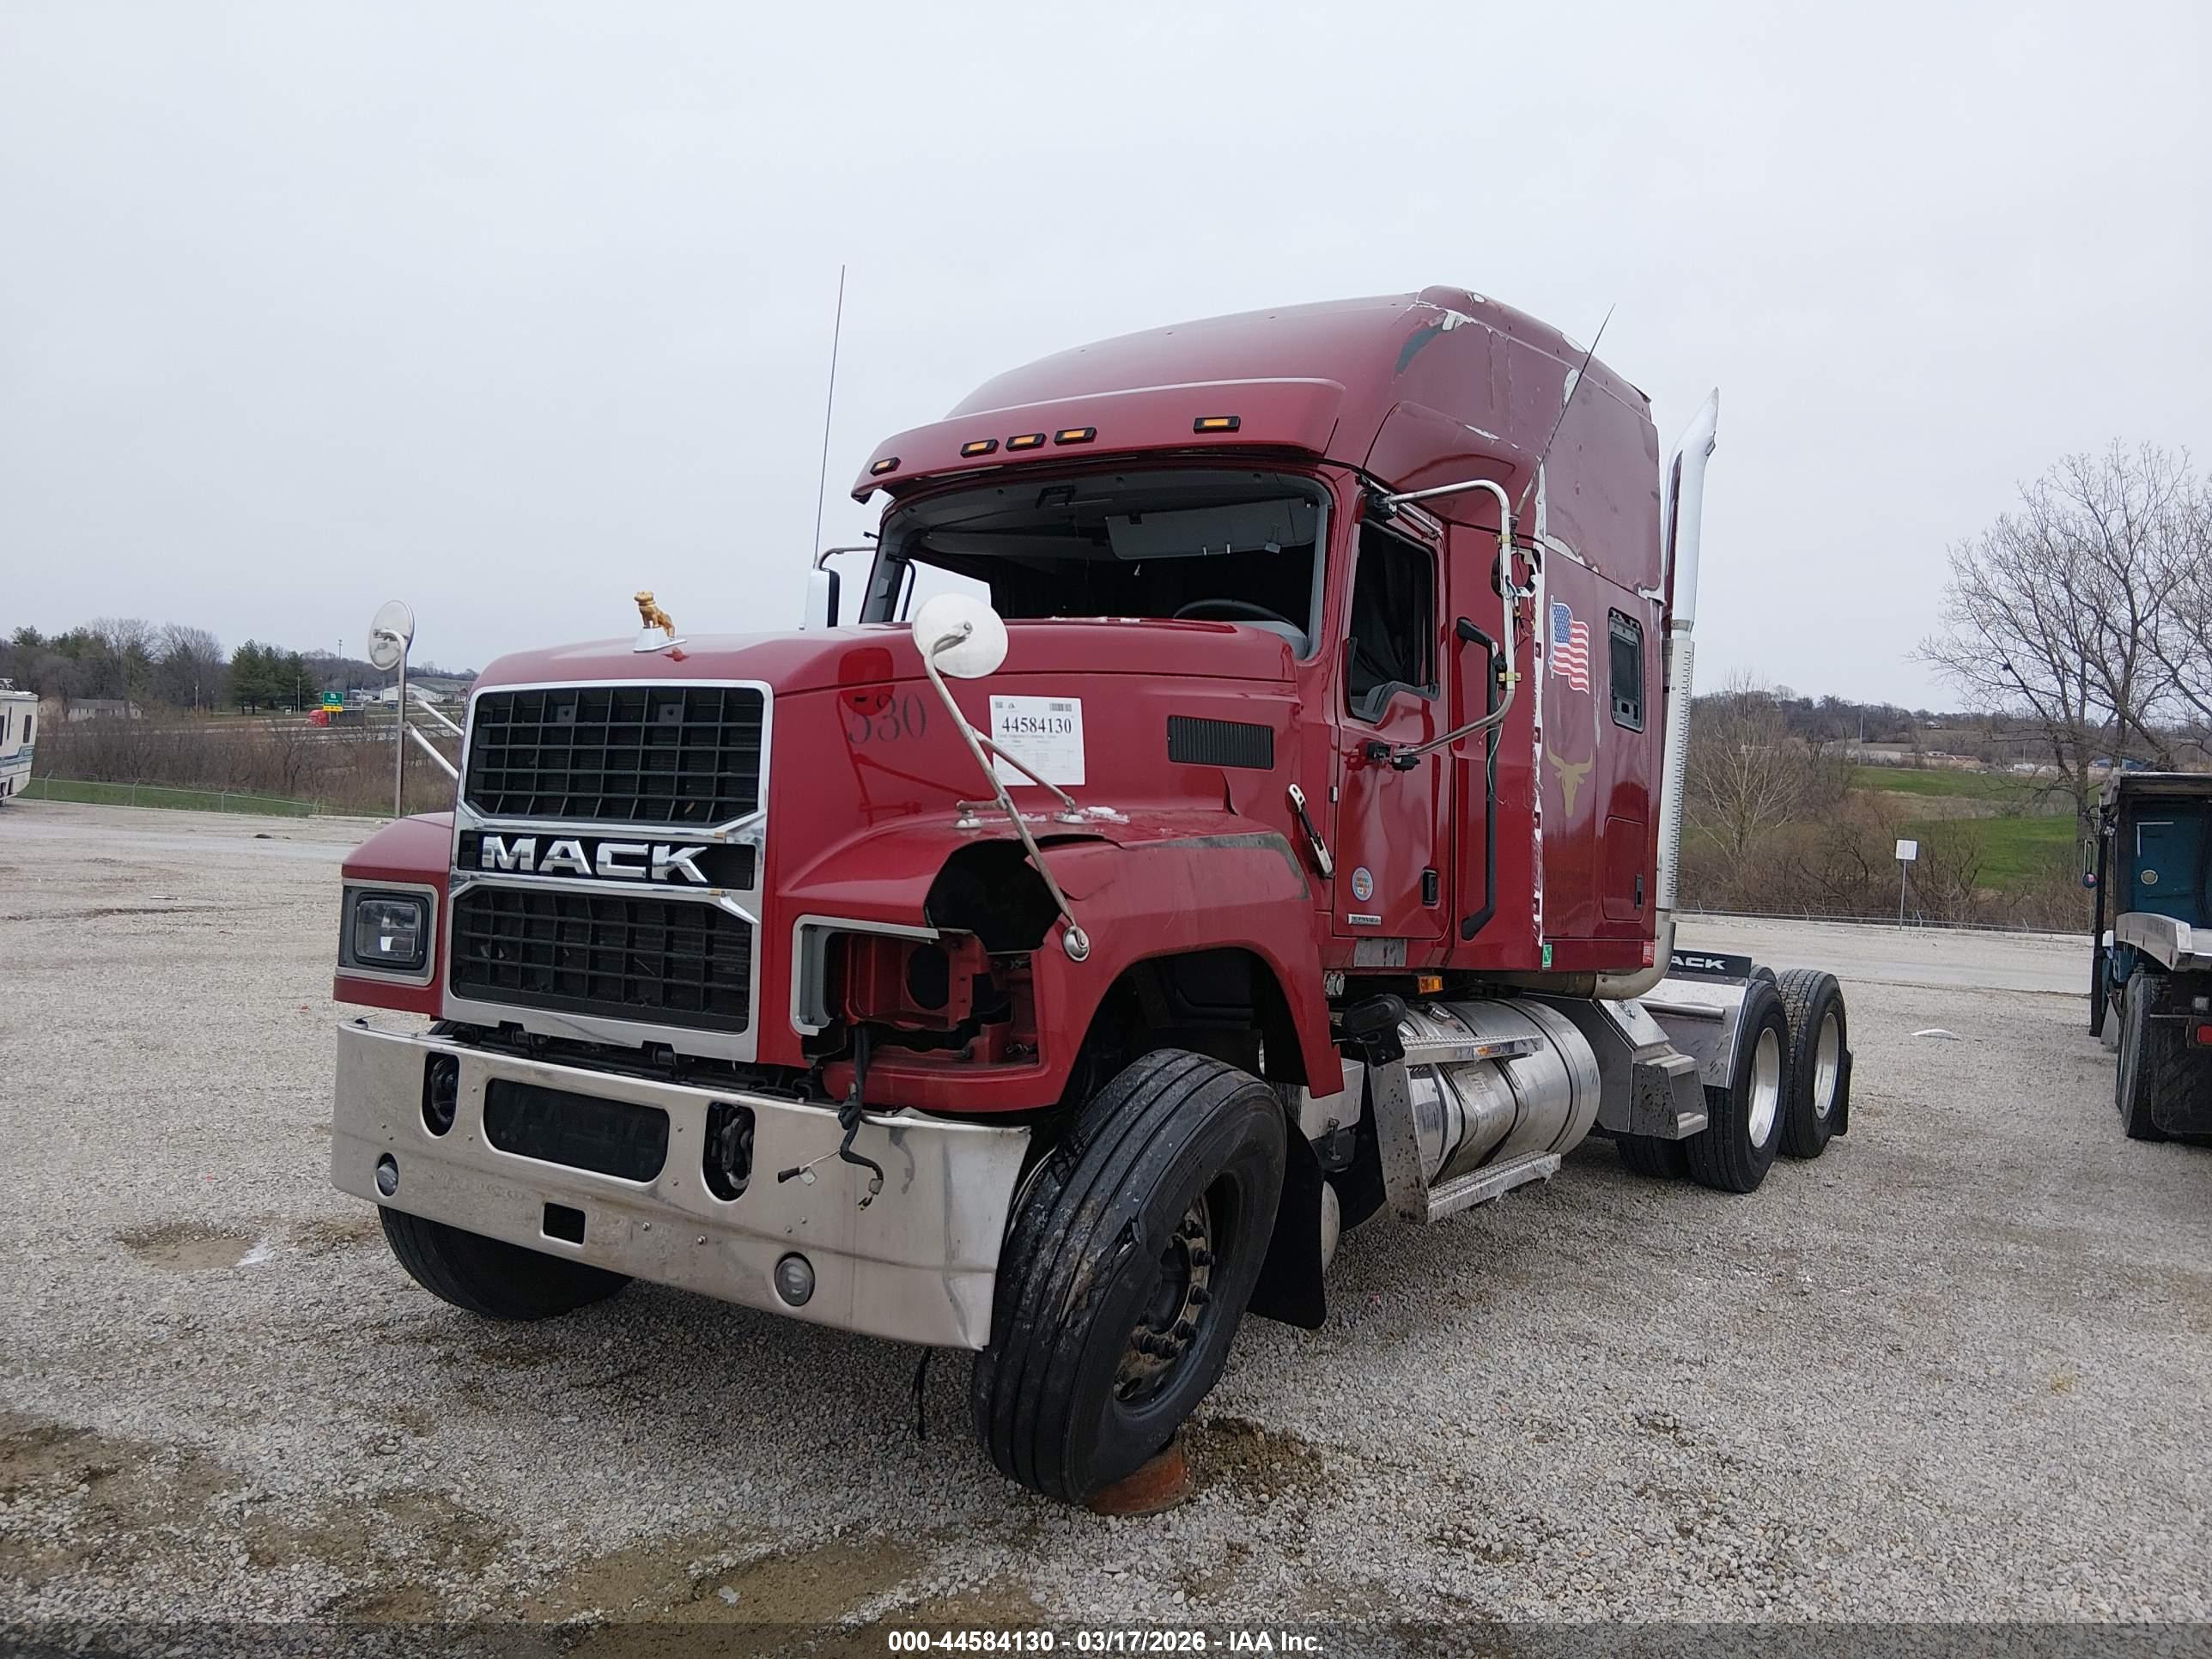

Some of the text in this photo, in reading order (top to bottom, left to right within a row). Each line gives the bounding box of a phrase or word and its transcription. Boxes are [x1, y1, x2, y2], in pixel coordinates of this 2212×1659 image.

[848, 692, 927, 744] 530
[1002, 715, 1072, 734] 44584130
[481, 836, 709, 884] MACK
[1670, 955, 1726, 970] ACK
